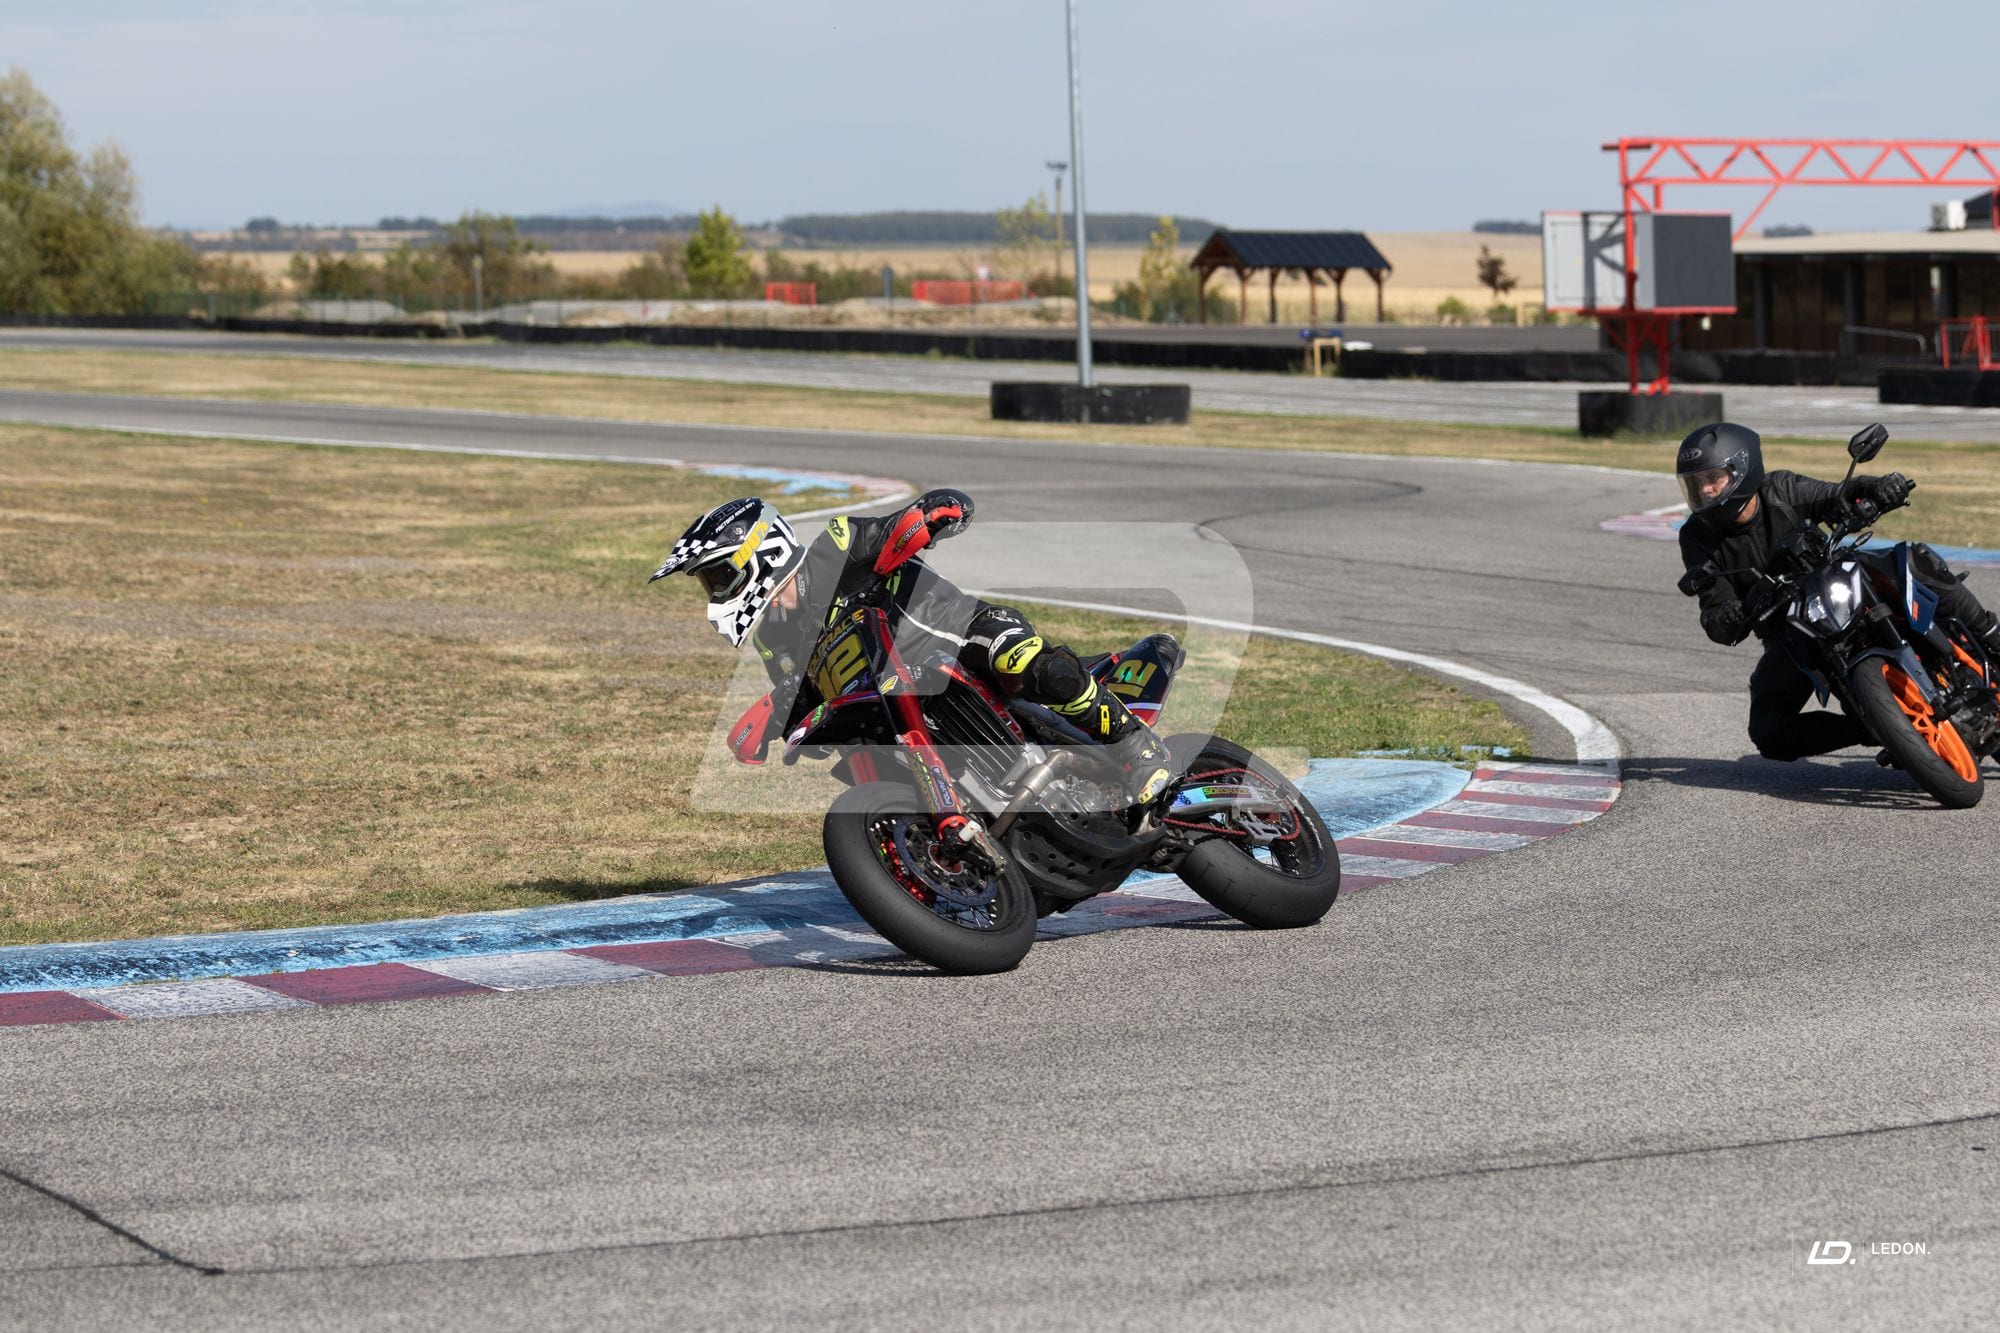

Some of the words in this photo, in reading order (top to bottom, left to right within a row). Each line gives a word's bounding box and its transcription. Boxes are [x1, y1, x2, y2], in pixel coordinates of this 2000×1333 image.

[731, 521, 769, 571] 100%
[816, 633, 869, 701] 12
[1006, 640, 1038, 670] 4SR
[1106, 659, 1158, 698] 12
